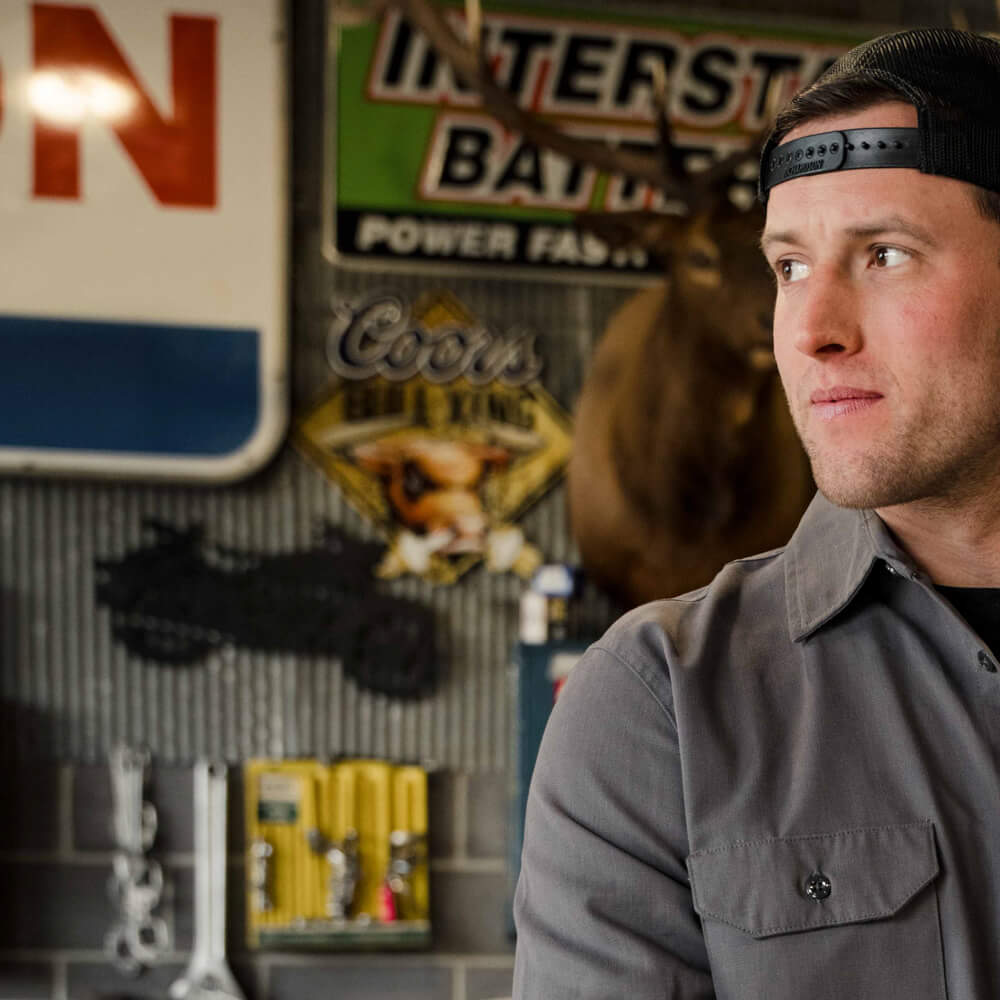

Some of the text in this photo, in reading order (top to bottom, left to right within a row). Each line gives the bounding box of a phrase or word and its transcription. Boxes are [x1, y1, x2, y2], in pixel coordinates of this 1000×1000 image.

[0, 3, 219, 211] N
[356, 215, 520, 259] POWER
[327, 296, 542, 385] Coors
